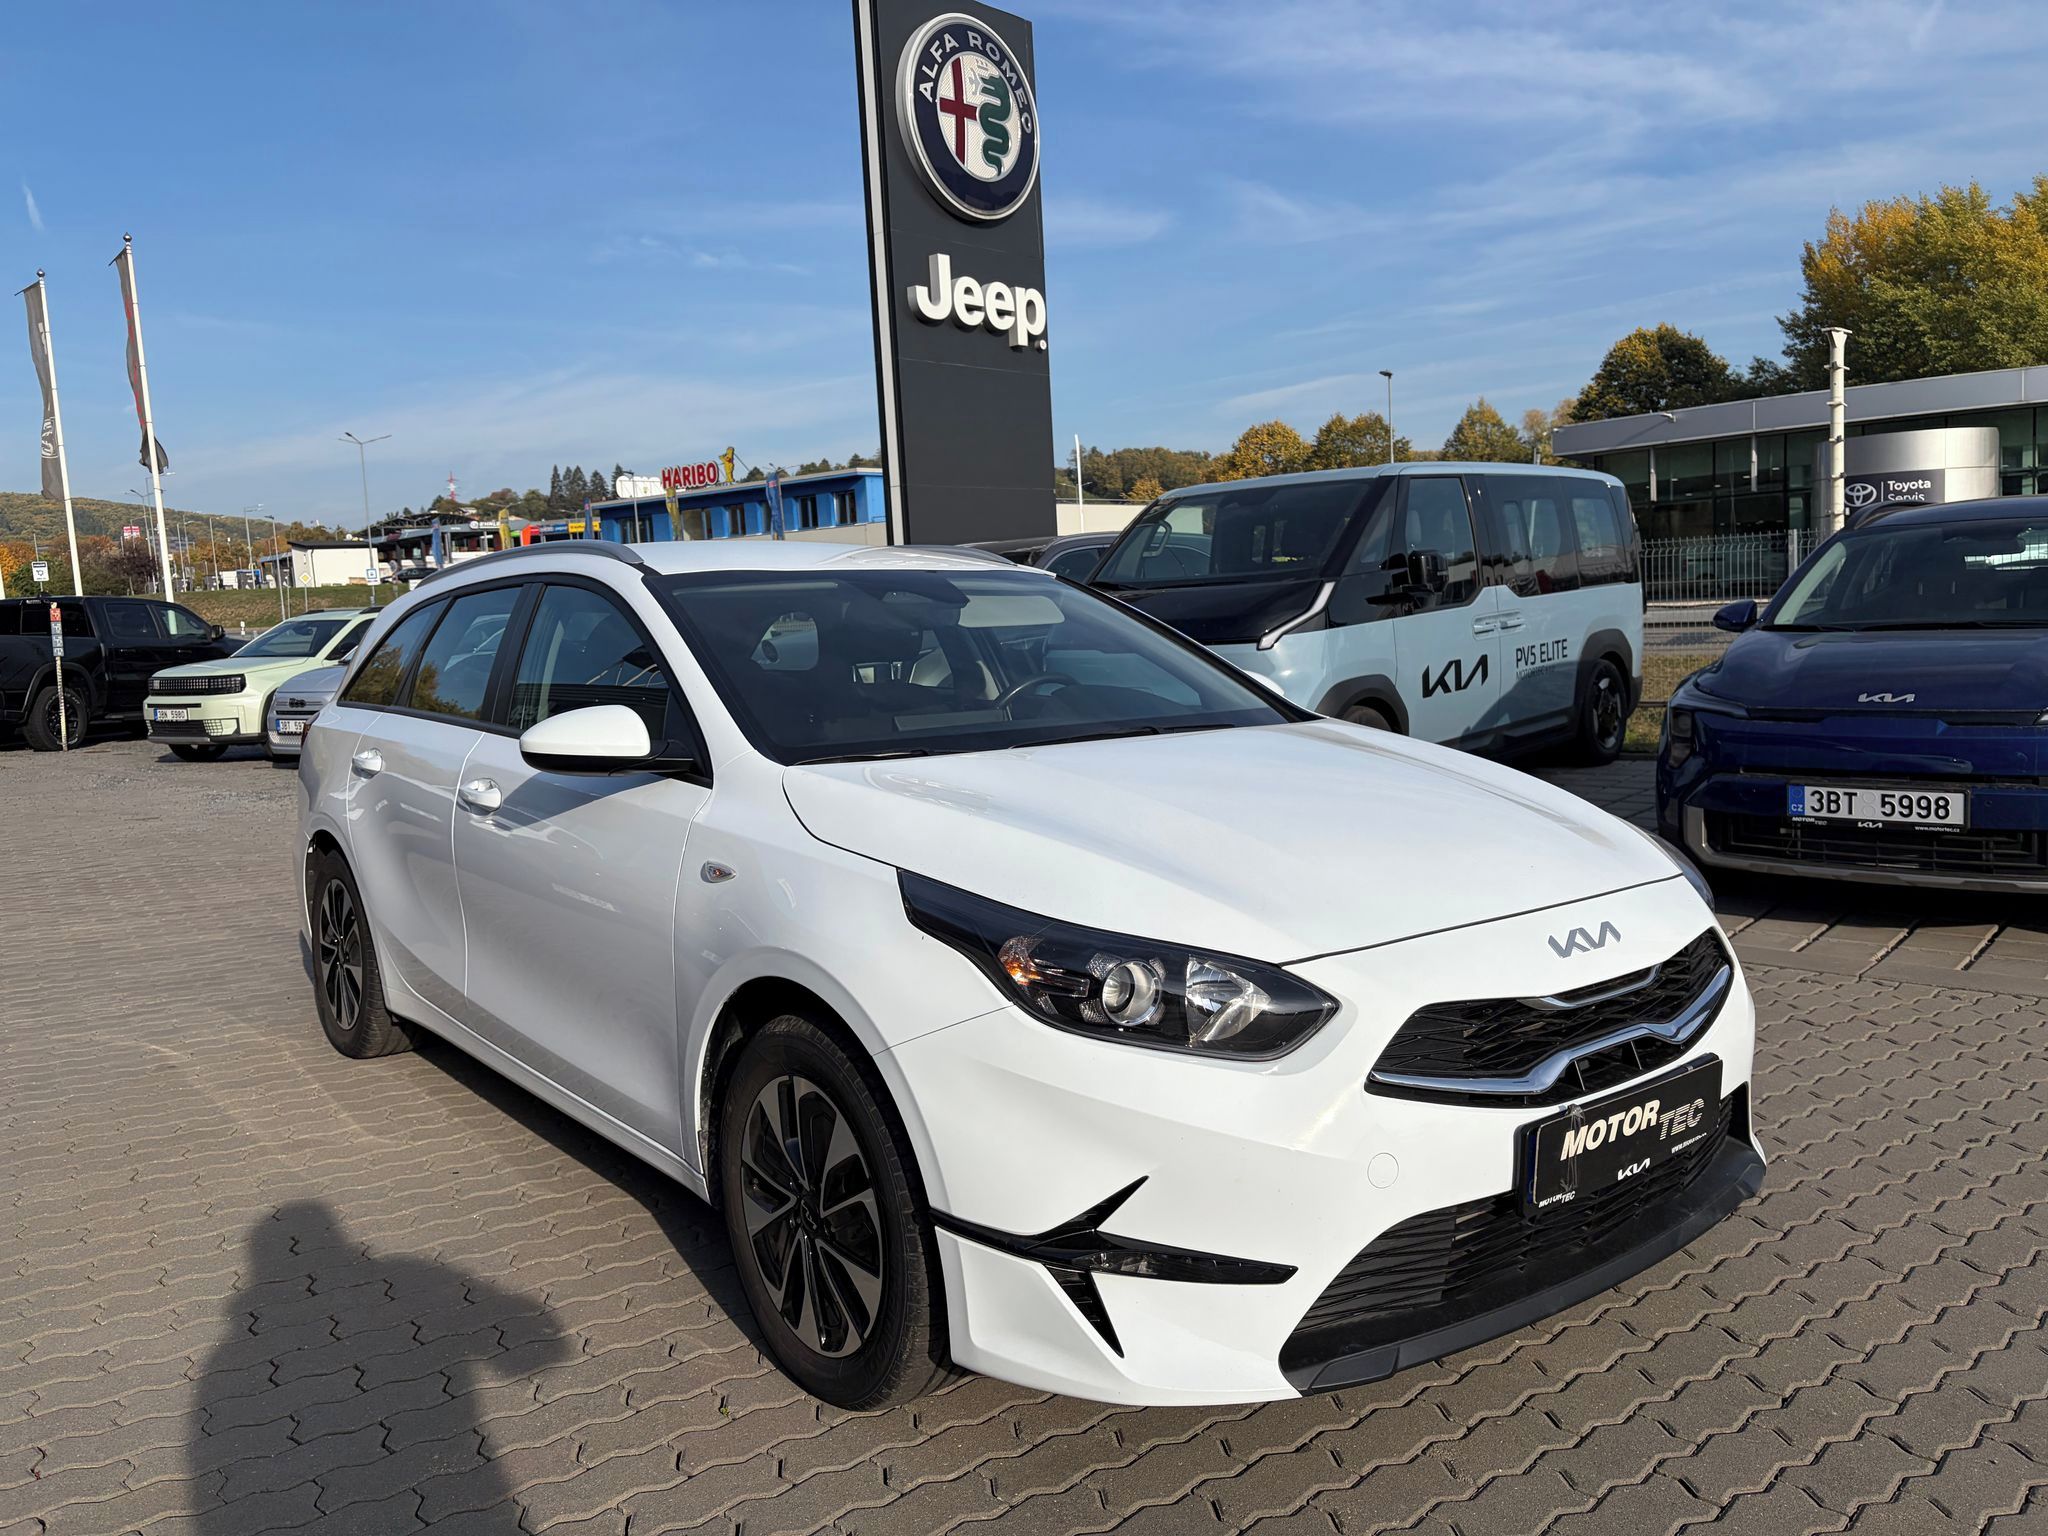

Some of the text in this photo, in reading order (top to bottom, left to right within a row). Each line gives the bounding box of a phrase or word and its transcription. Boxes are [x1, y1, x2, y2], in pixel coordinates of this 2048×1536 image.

[919, 30, 1032, 134] ALFA ROMEO
[907, 253, 1046, 347] Jeep
[661, 461, 719, 489] HARIBO
[1887, 479, 1932, 492] Toyota
[1515, 638, 1568, 669] PV5 ELITE
[1421, 653, 1488, 698] KIA
[1858, 692, 1915, 703] KIA
[1791, 803, 1803, 811] CZ
[1809, 790, 1950, 820] 3BT 5998
[1857, 821, 1883, 829] KIA
[1547, 920, 1622, 958] KIA
[1617, 1157, 1651, 1182] KIA
